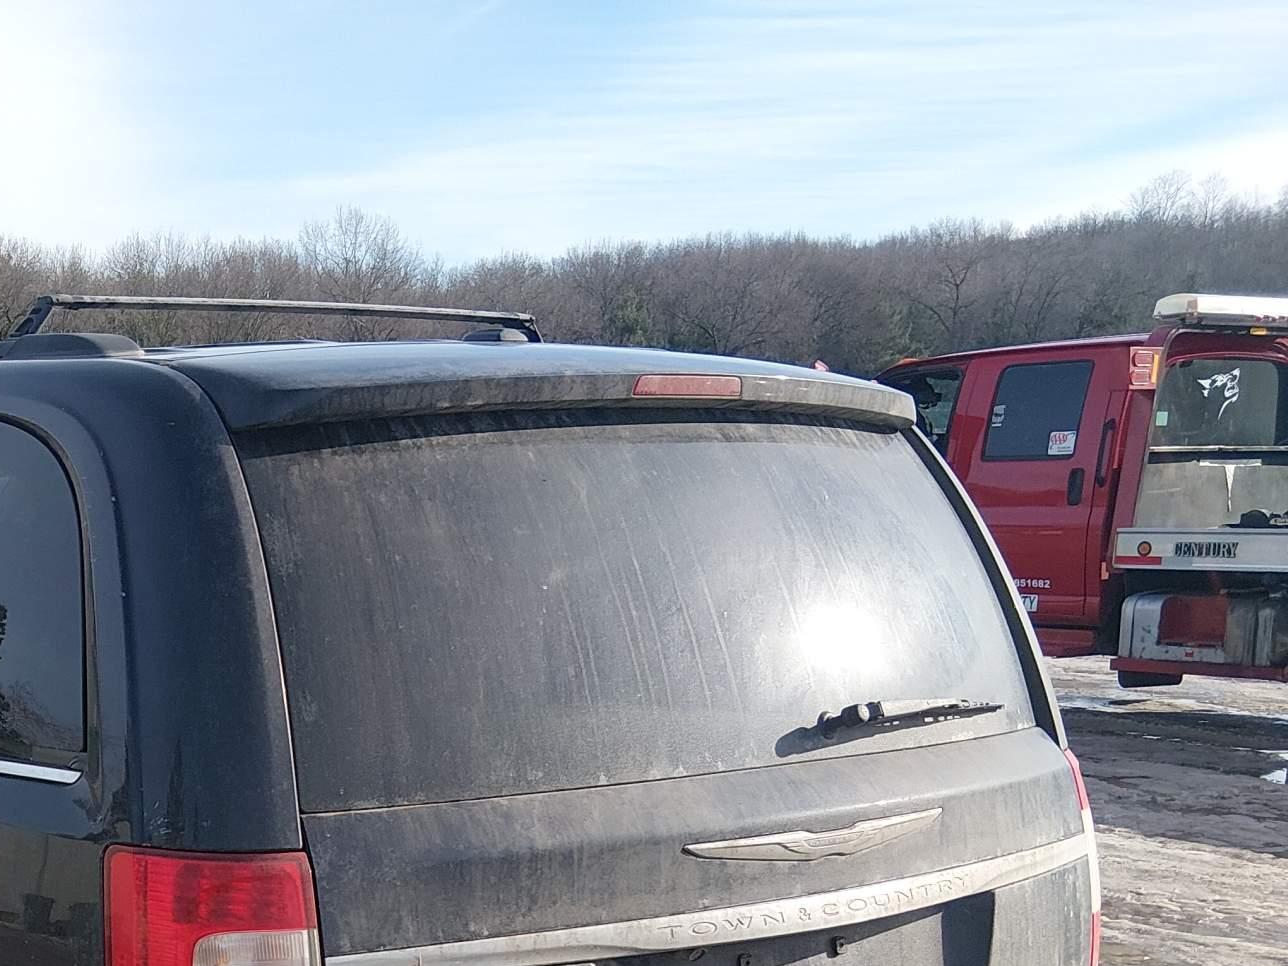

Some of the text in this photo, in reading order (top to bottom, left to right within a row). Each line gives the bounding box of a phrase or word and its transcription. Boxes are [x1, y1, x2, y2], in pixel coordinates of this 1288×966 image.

[1175, 541, 1239, 559] CENTURY
[656, 874, 969, 940] TOWN & COUNTRY
